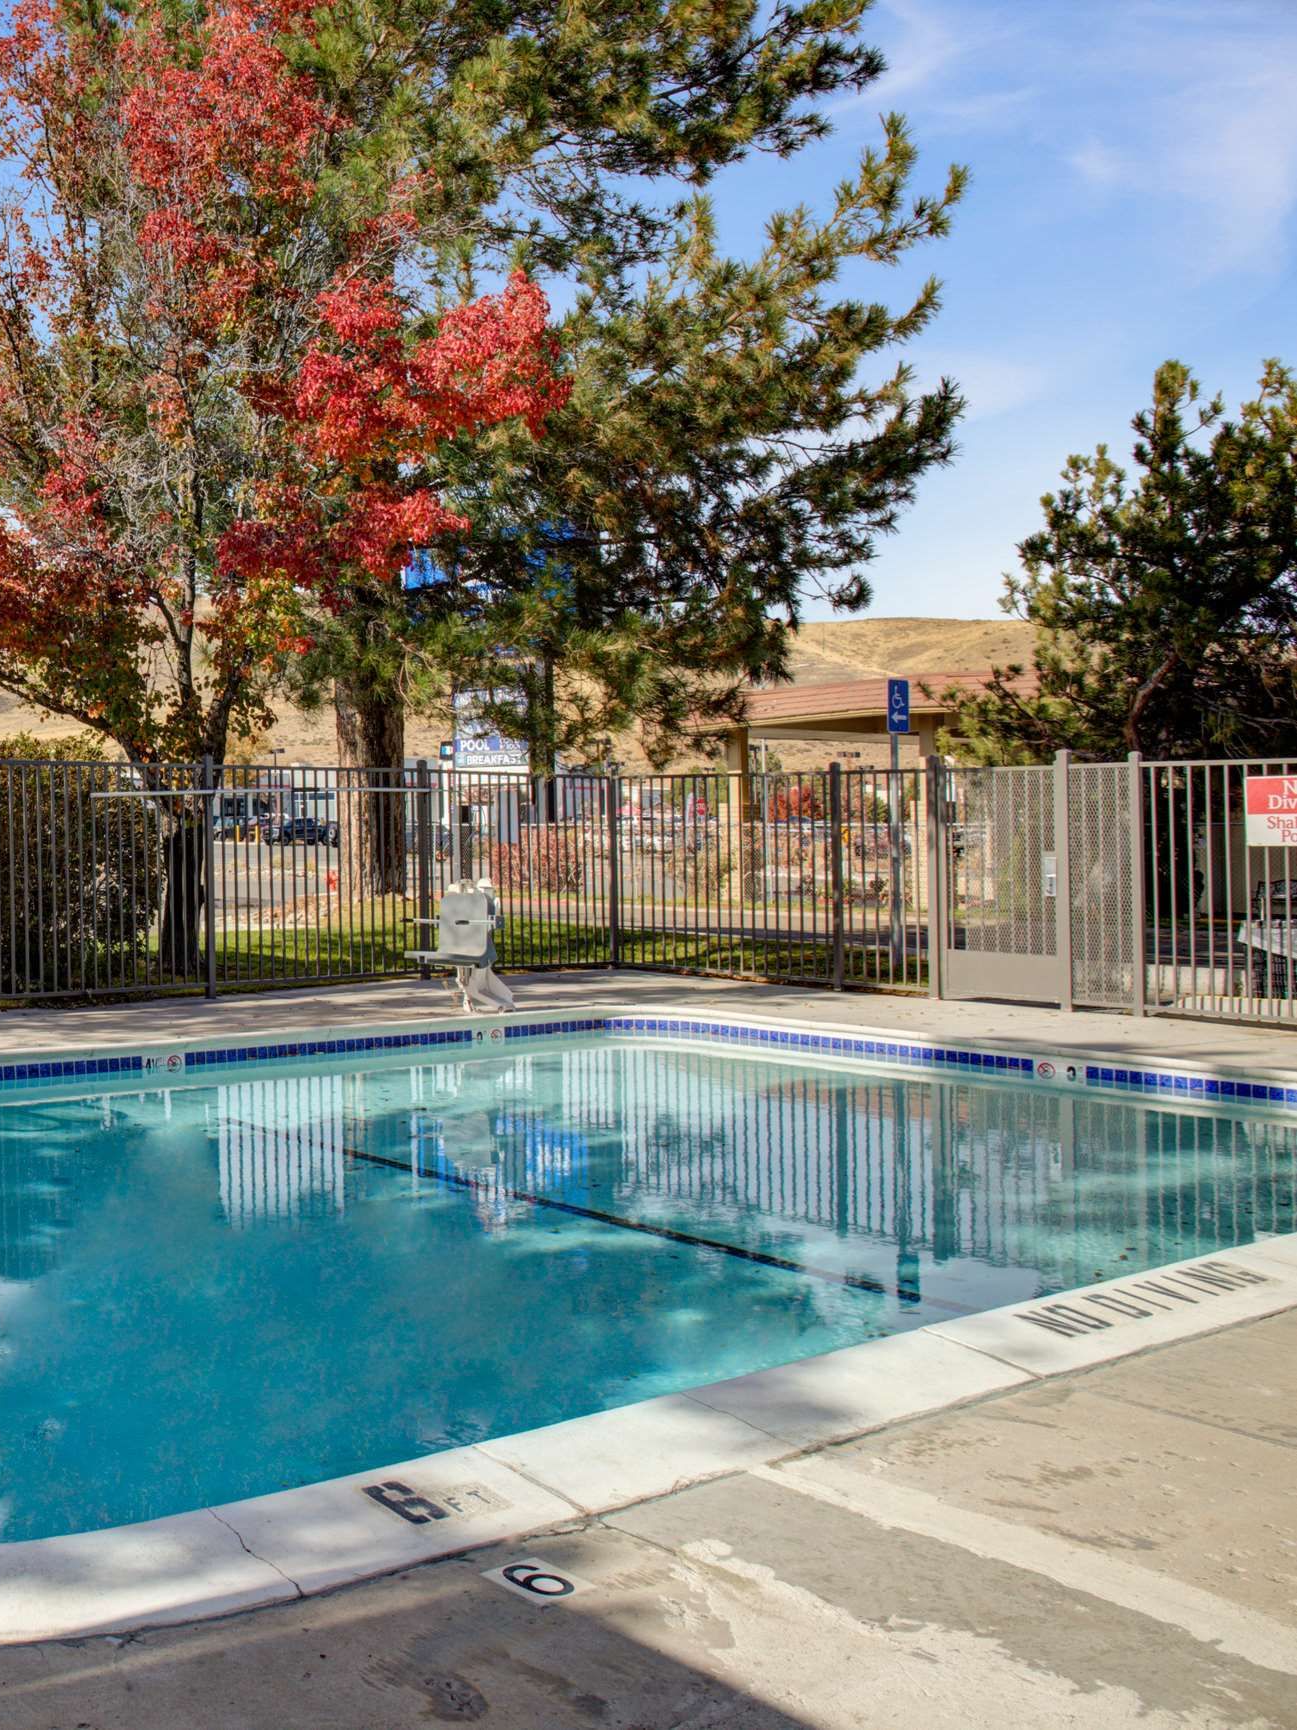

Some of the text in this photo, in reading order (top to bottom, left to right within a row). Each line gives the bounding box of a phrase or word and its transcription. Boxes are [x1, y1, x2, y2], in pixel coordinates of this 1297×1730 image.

[460, 738, 490, 752] POOL
[1013, 1261, 1269, 1338] NO DIVING
[502, 1564, 576, 1597] 6
